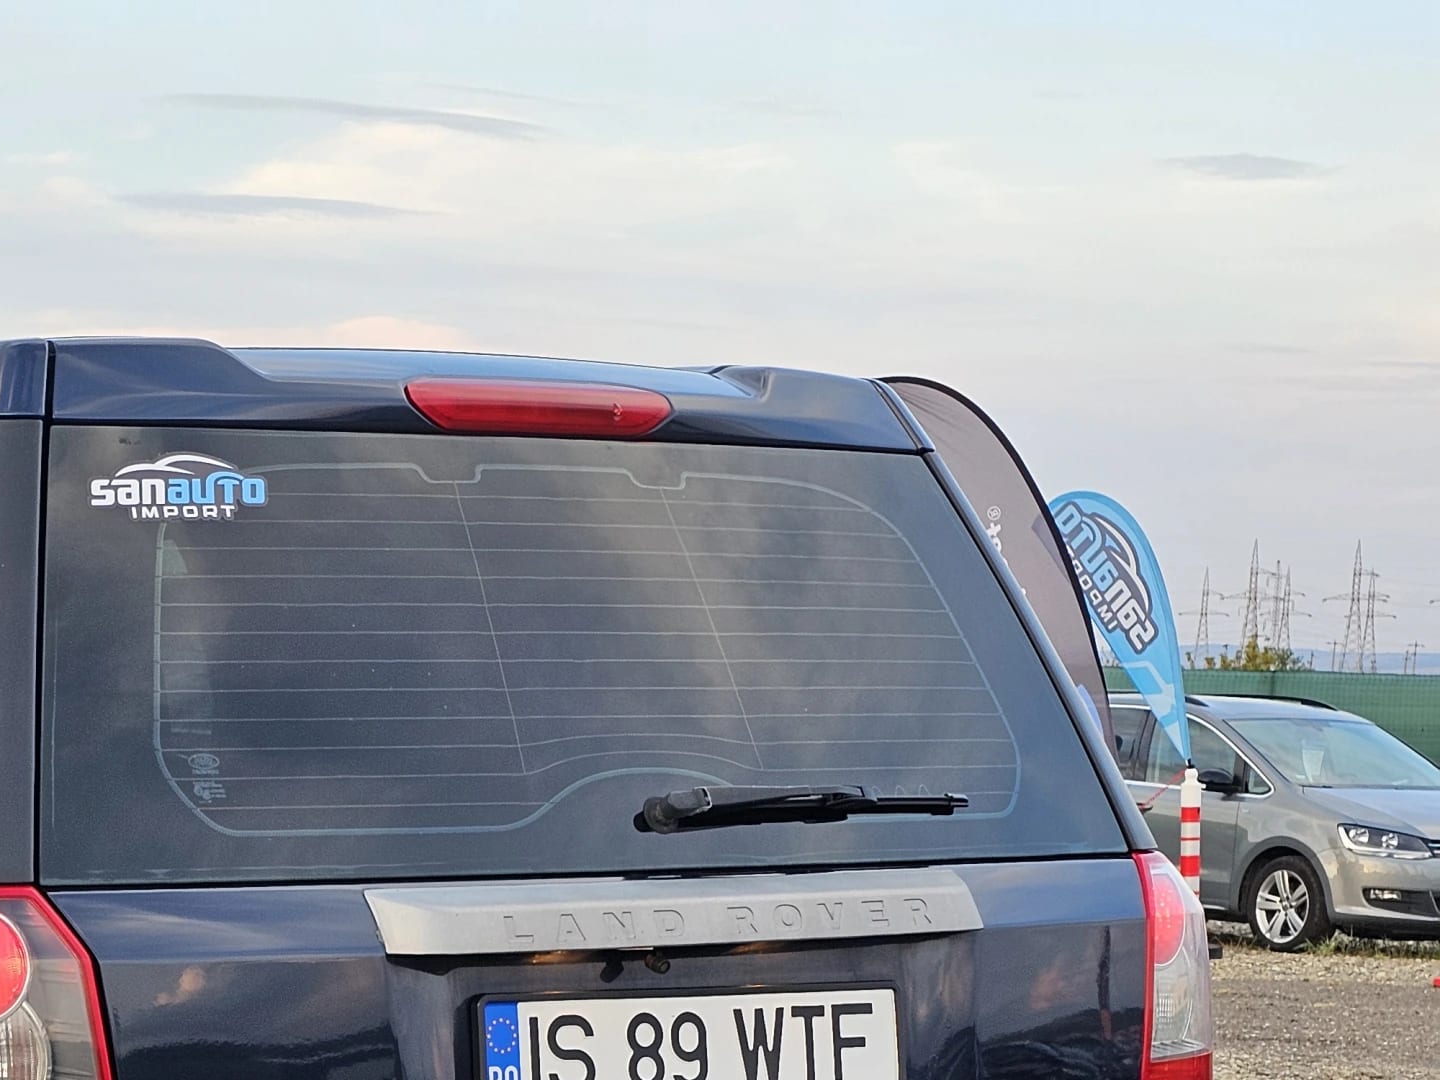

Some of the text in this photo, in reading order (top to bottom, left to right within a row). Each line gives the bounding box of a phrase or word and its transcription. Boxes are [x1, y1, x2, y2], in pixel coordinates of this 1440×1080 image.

[131, 504, 236, 519] IMPORT
[503, 897, 933, 944] LAND ROVER
